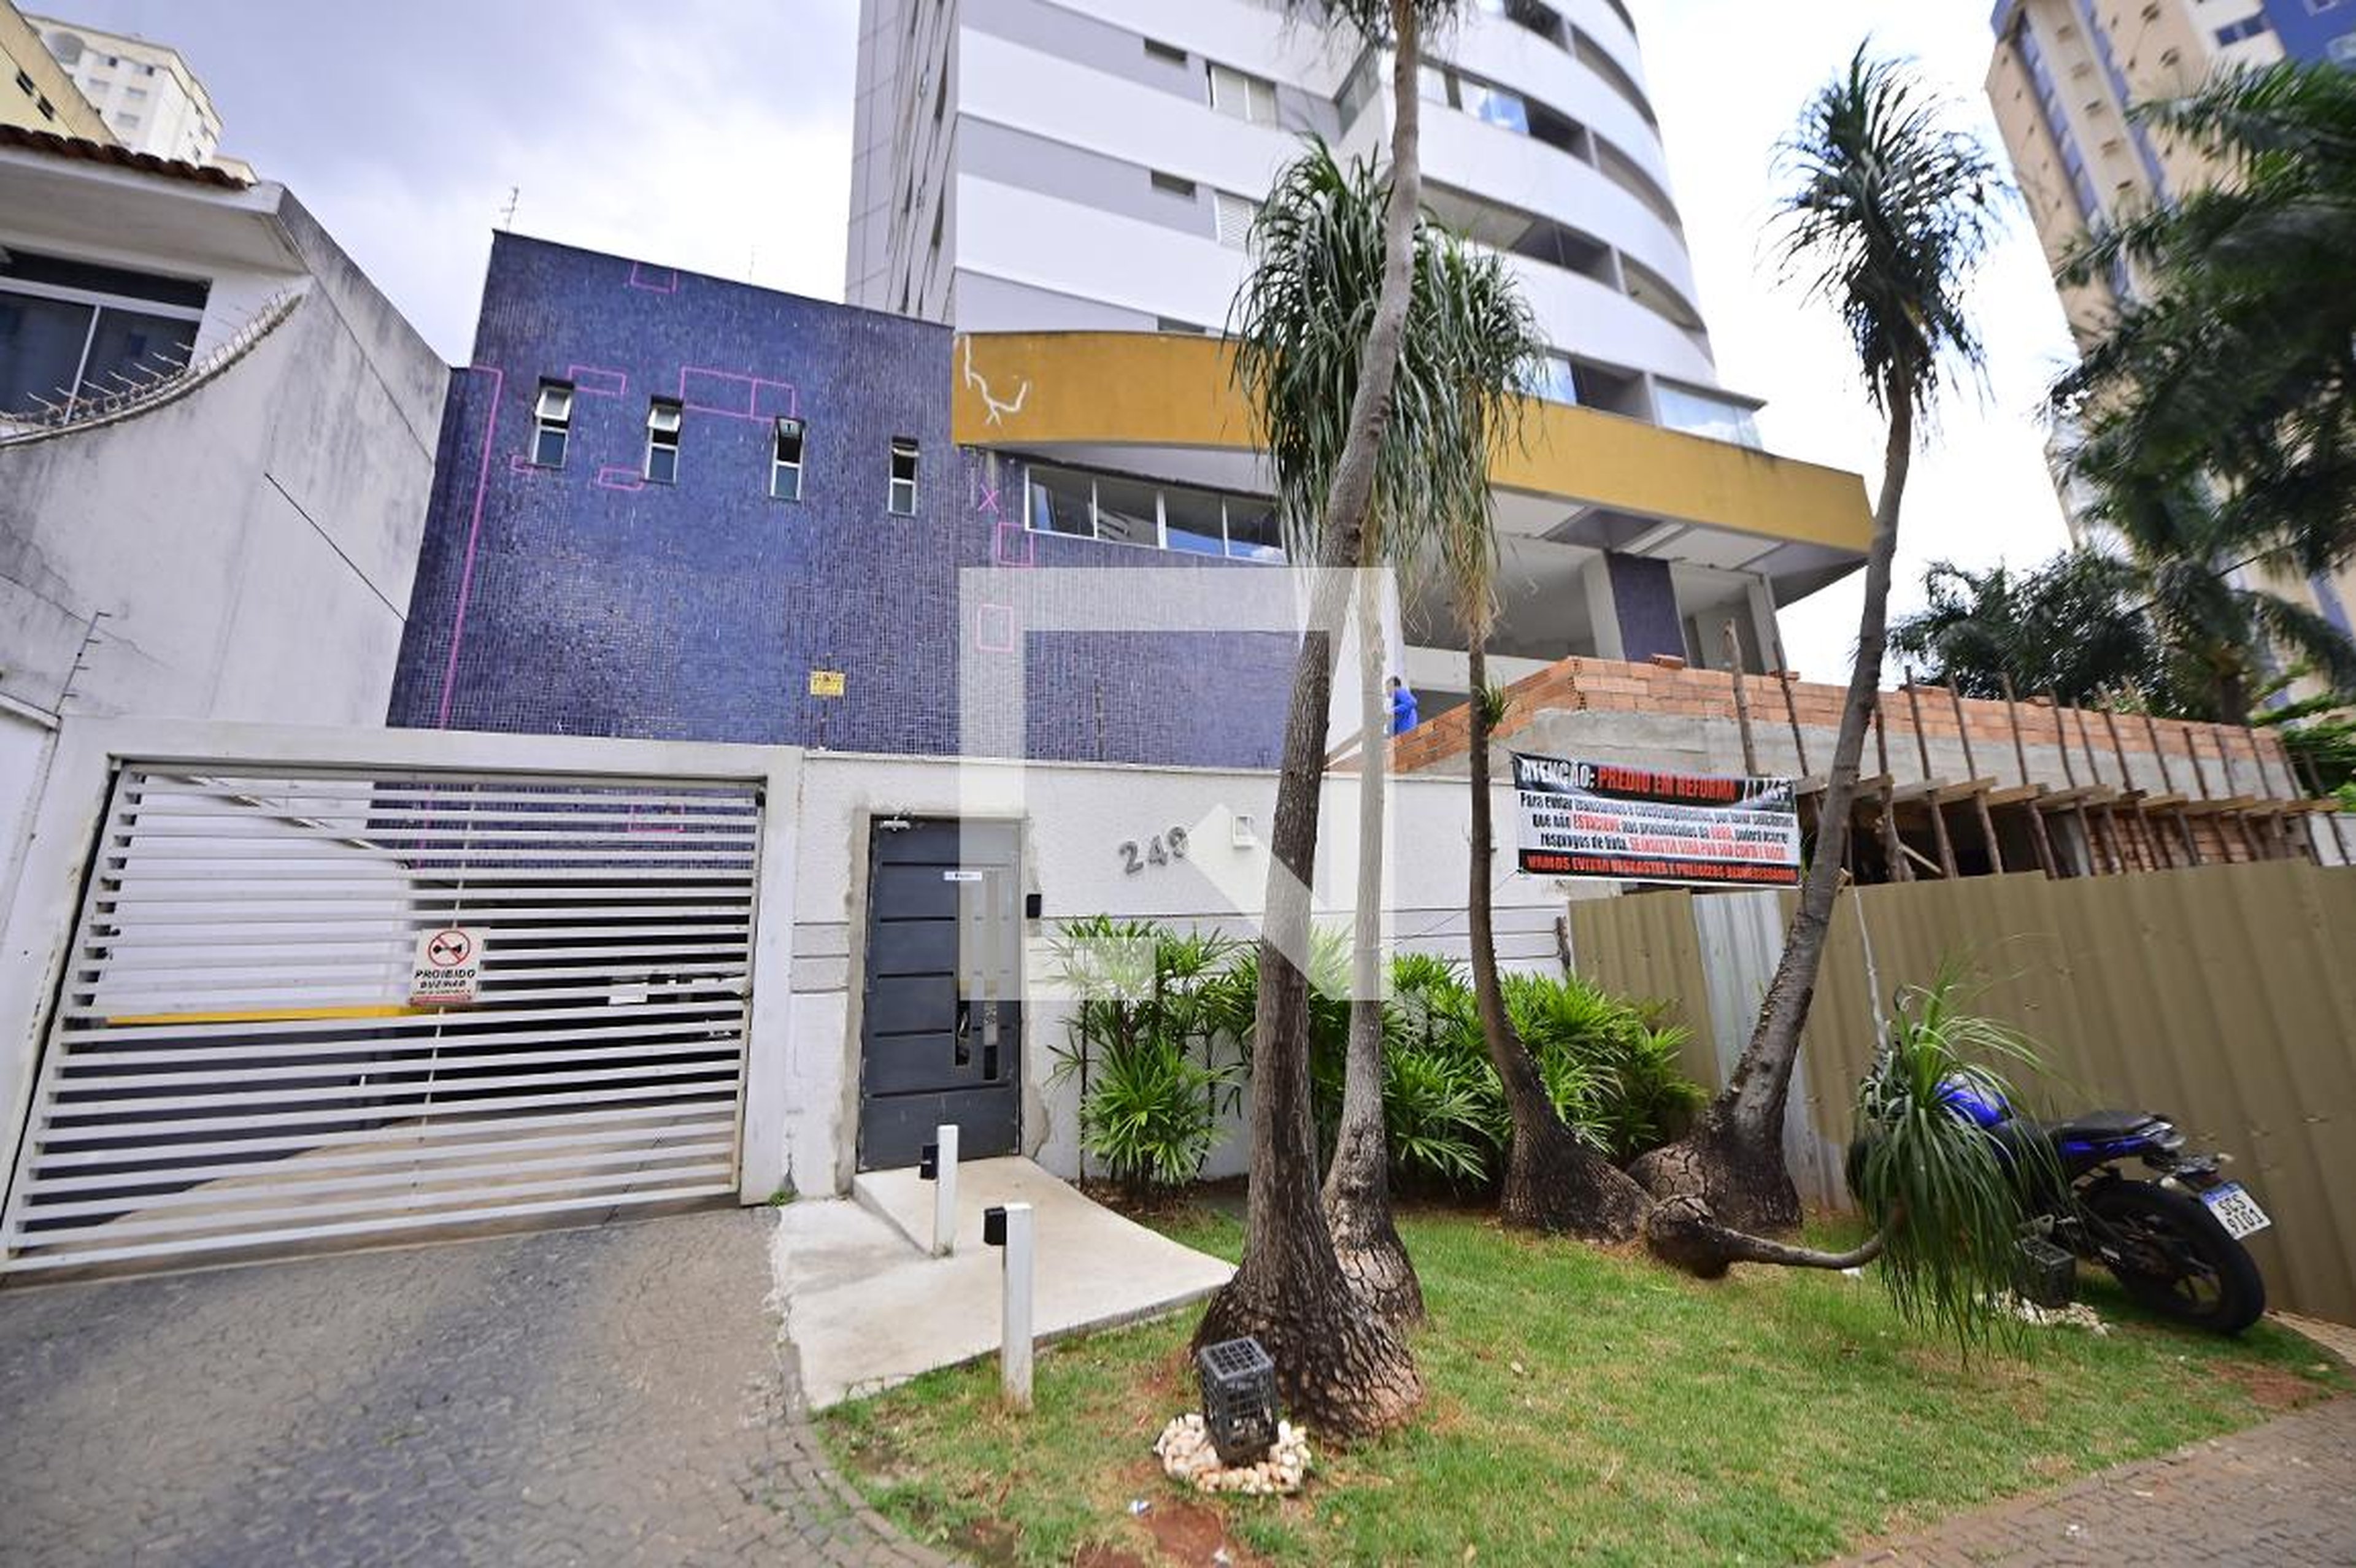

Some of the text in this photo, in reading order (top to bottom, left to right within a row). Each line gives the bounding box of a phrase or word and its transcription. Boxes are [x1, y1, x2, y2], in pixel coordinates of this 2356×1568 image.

[1656, 771, 1674, 796] EM
[1677, 775, 1737, 801] REFORMA
[1520, 792, 1544, 809] Para
[1545, 794, 1573, 810] evitar
[1533, 813, 1552, 828] que
[1553, 813, 1571, 829] não
[1592, 835, 1603, 849] de
[1526, 855, 1571, 870] VAMOS
[414, 969, 476, 980] PROIBIDO
